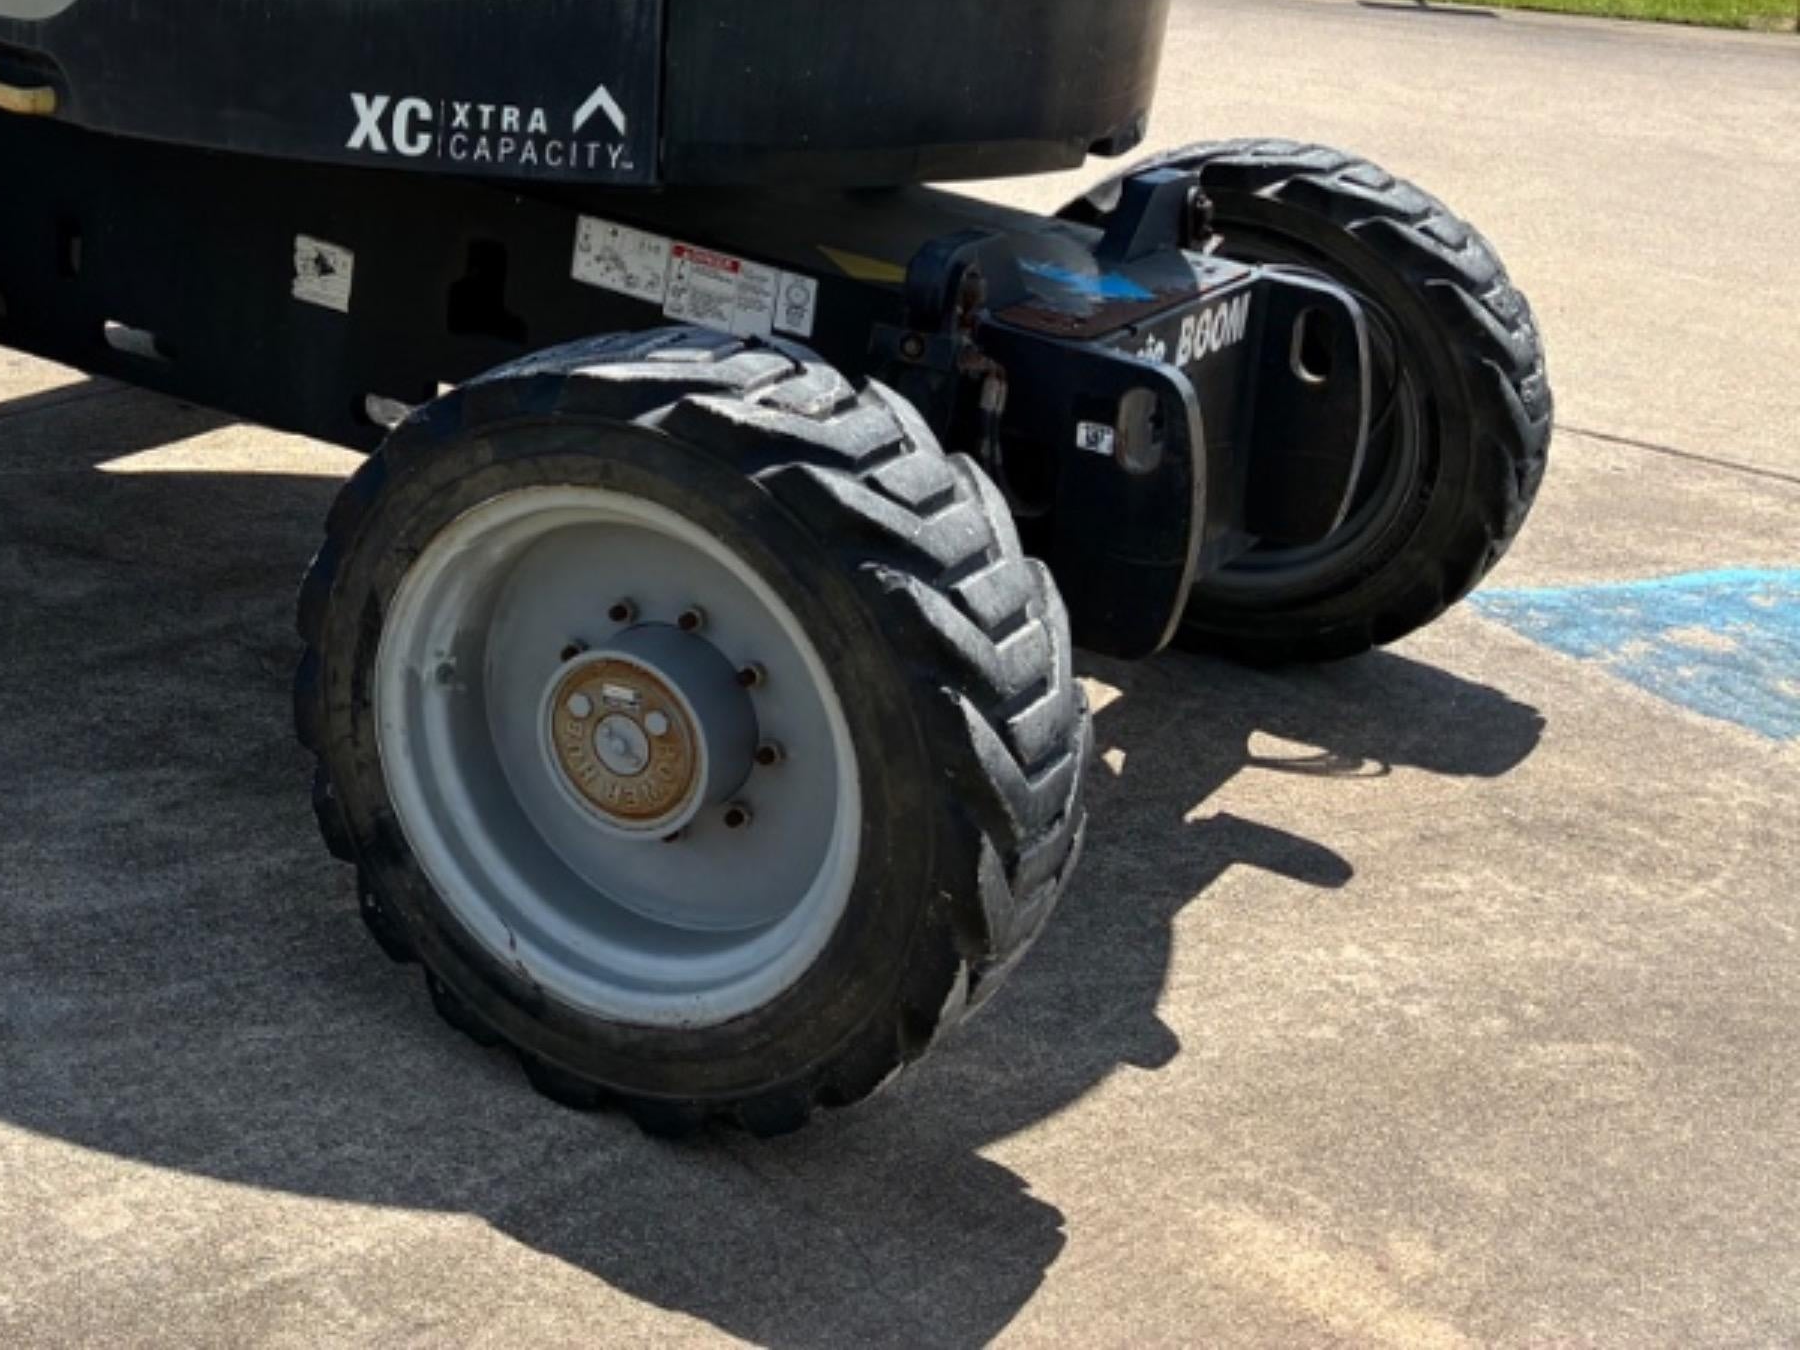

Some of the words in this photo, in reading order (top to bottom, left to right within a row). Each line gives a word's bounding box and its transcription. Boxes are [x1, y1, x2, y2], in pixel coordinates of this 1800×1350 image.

[345, 91, 433, 157] XC
[451, 101, 548, 135] XTRA
[450, 133, 624, 170] CAPACITY
[1175, 290, 1252, 368] BOOM
